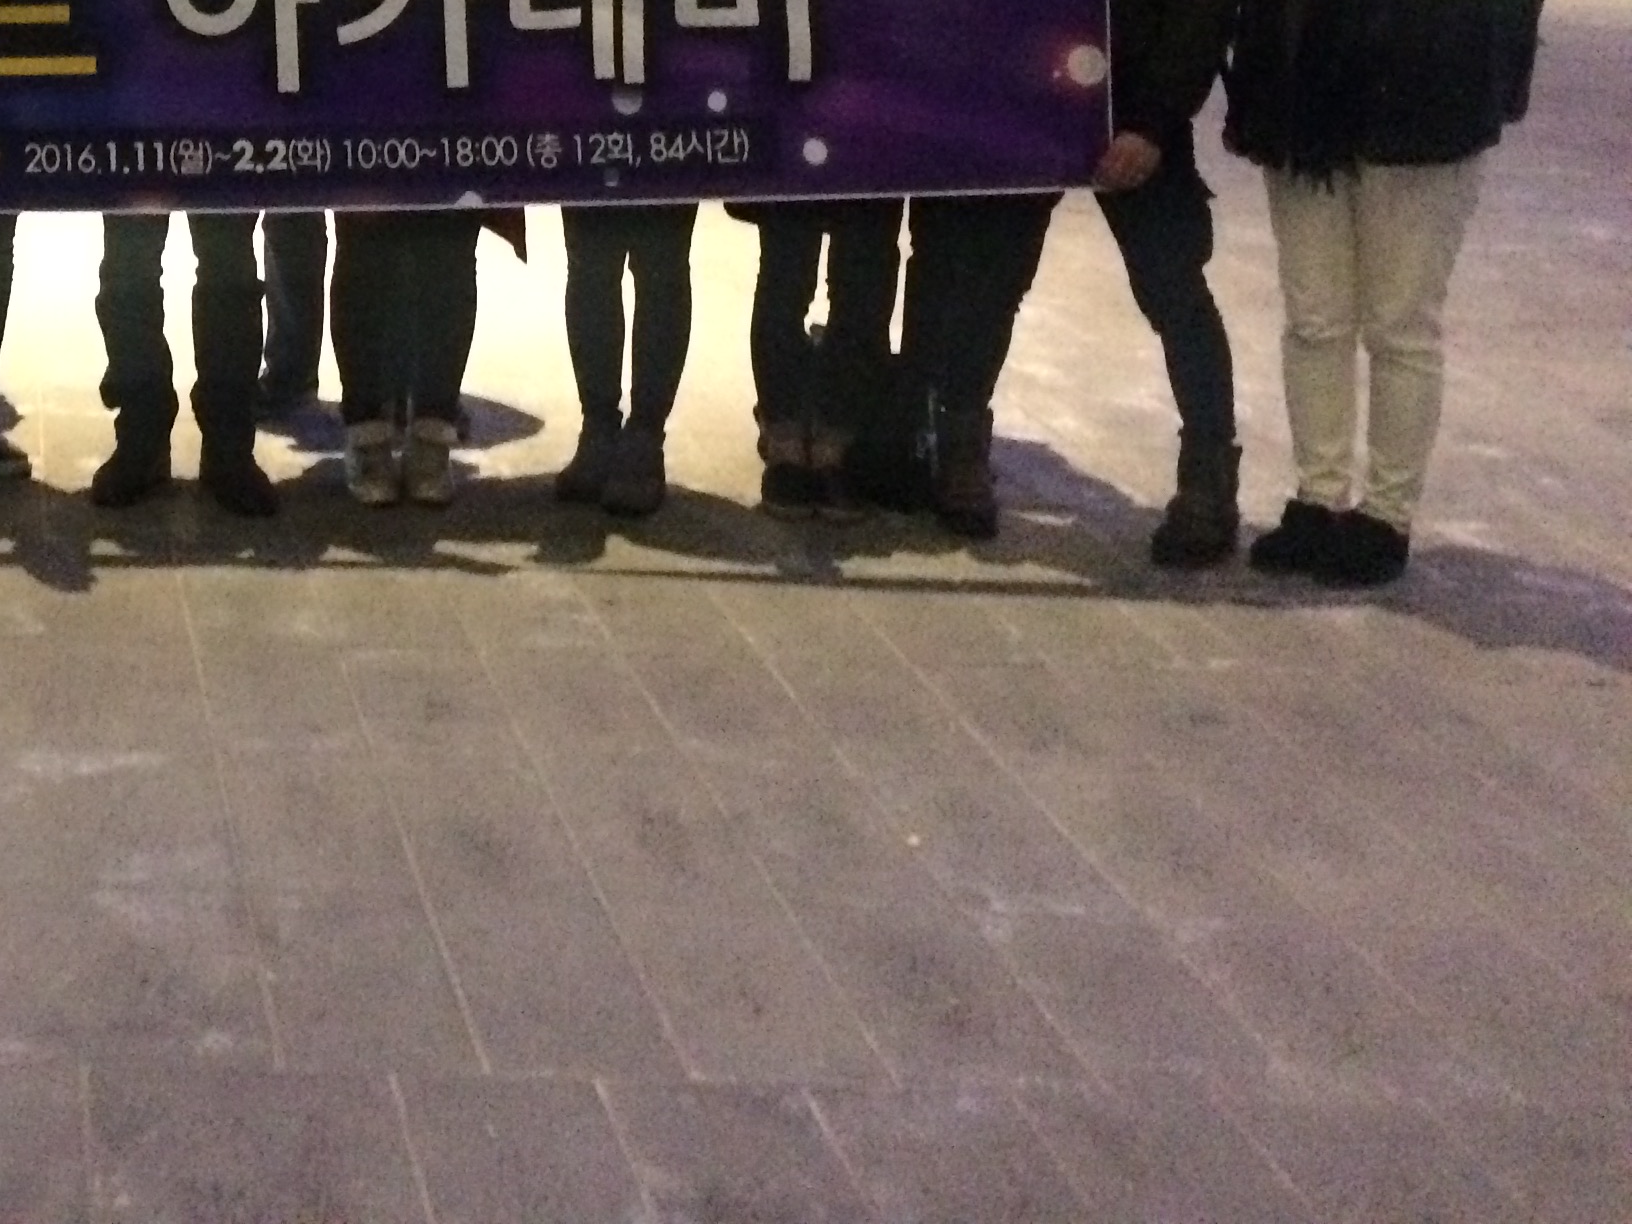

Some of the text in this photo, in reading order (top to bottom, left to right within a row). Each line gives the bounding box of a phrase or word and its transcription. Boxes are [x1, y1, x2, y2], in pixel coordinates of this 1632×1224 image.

[526, 133, 563, 169] (총
[573, 132, 641, 168] 12회,
[649, 128, 750, 164] 84시간)
